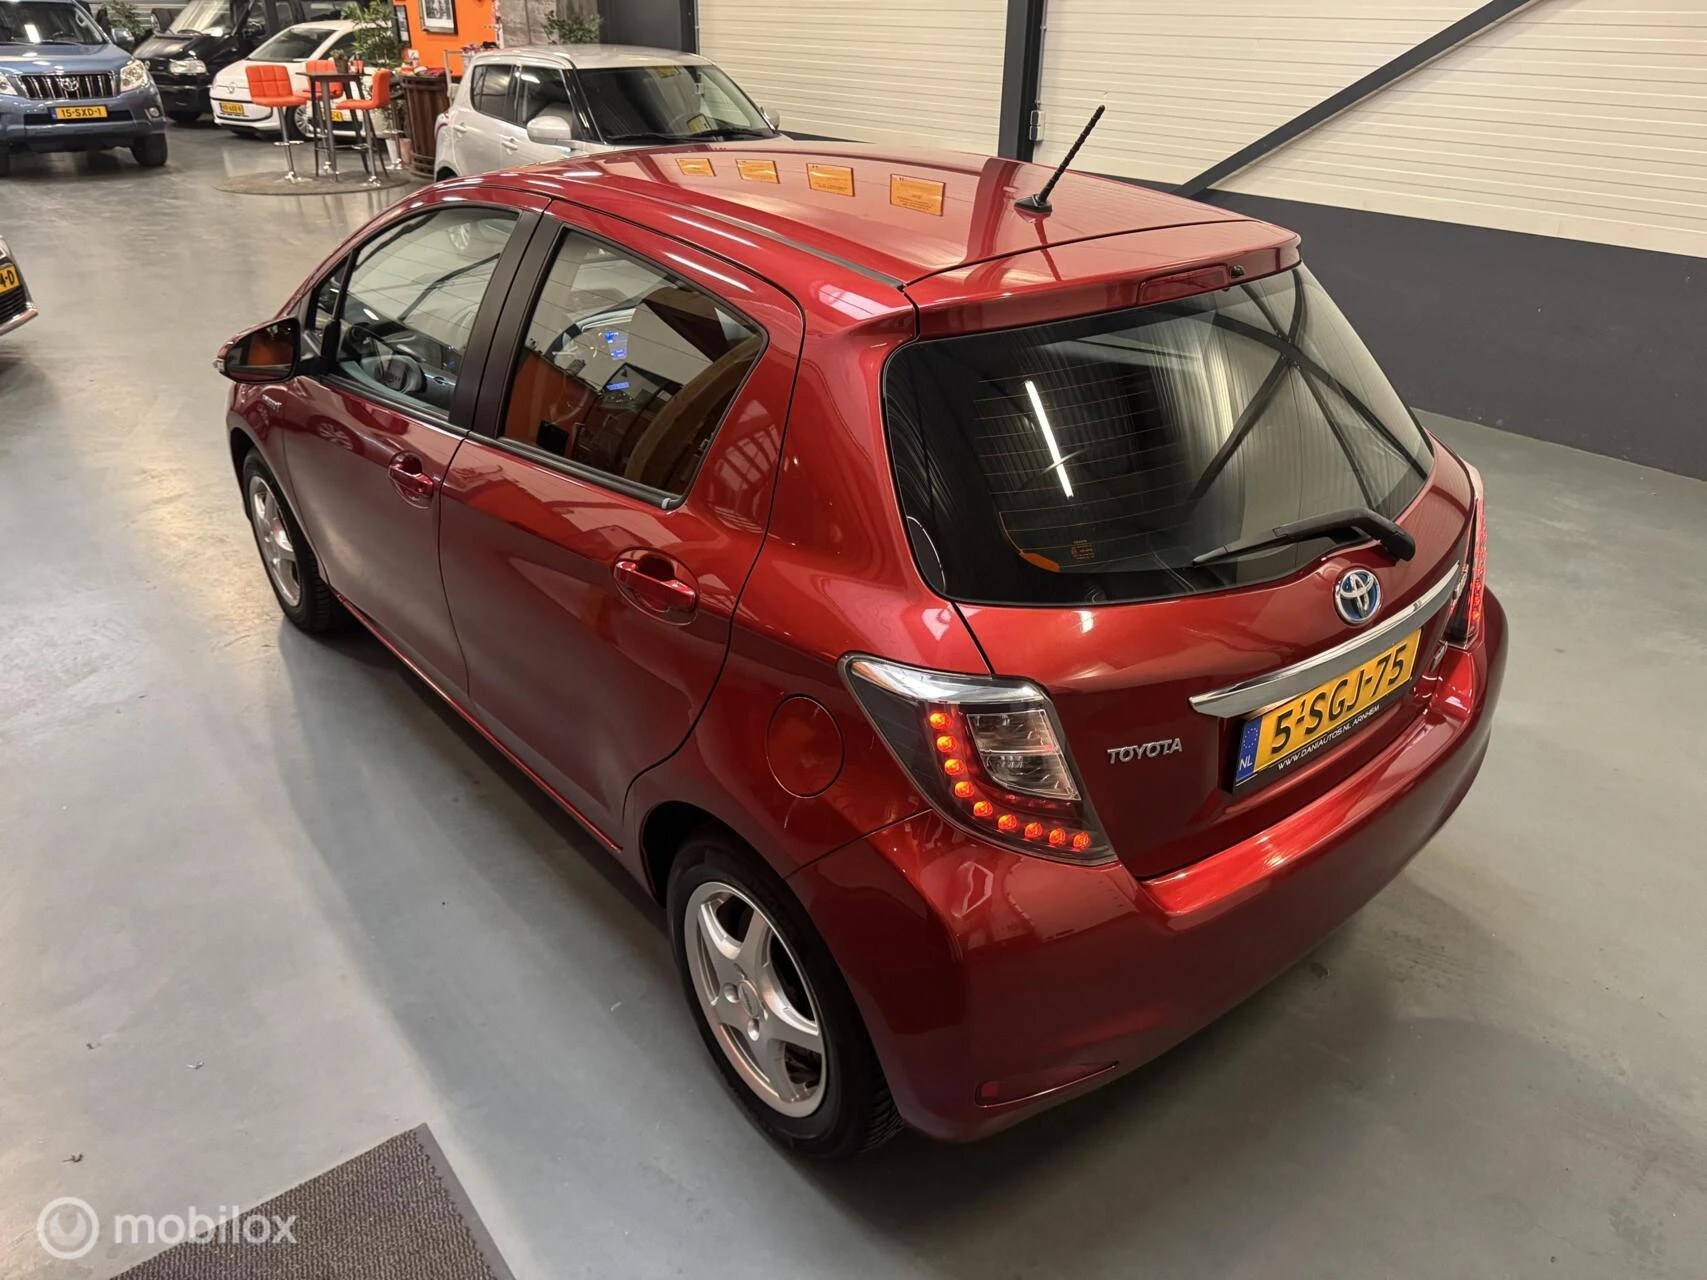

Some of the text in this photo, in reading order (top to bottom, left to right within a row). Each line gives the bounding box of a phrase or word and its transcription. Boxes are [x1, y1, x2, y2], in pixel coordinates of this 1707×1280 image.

[61, 107, 102, 117] 15-SXD-1
[1353, 704, 1380, 725] ARNHEM
[1107, 737, 1183, 765] TOYOTA
[1239, 754, 1253, 771] NL
